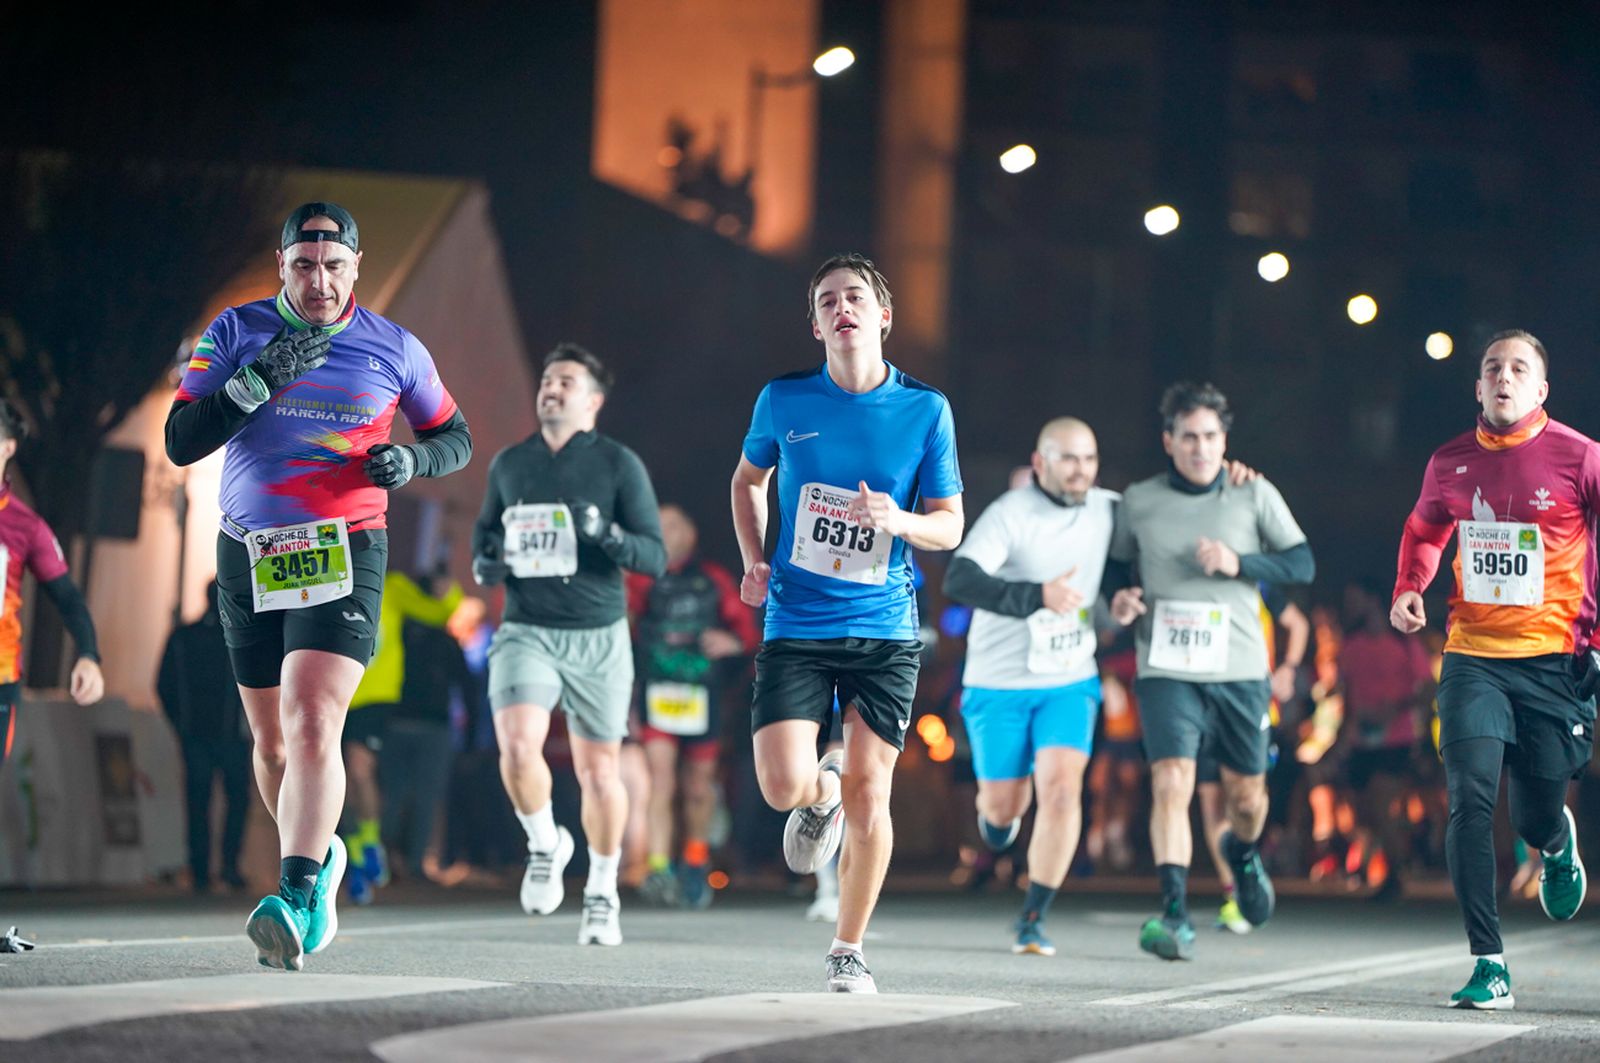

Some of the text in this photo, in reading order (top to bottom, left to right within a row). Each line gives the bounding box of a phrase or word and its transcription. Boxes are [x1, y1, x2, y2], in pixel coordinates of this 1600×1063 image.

[277, 398, 325, 411] ATLETISMO
[327, 402, 334, 411] Y
[276, 407, 375, 426] MANCHA REAL
[809, 502, 827, 516] SAN
[821, 495, 849, 508] NOCH
[268, 532, 296, 544] NOCHE
[297, 529, 309, 539] DE
[812, 516, 876, 553] 6313
[1475, 531, 1510, 540] NOCHE DE
[271, 548, 329, 582] 3457
[1473, 551, 1528, 577] 5950
[1168, 628, 1212, 647] 2619
